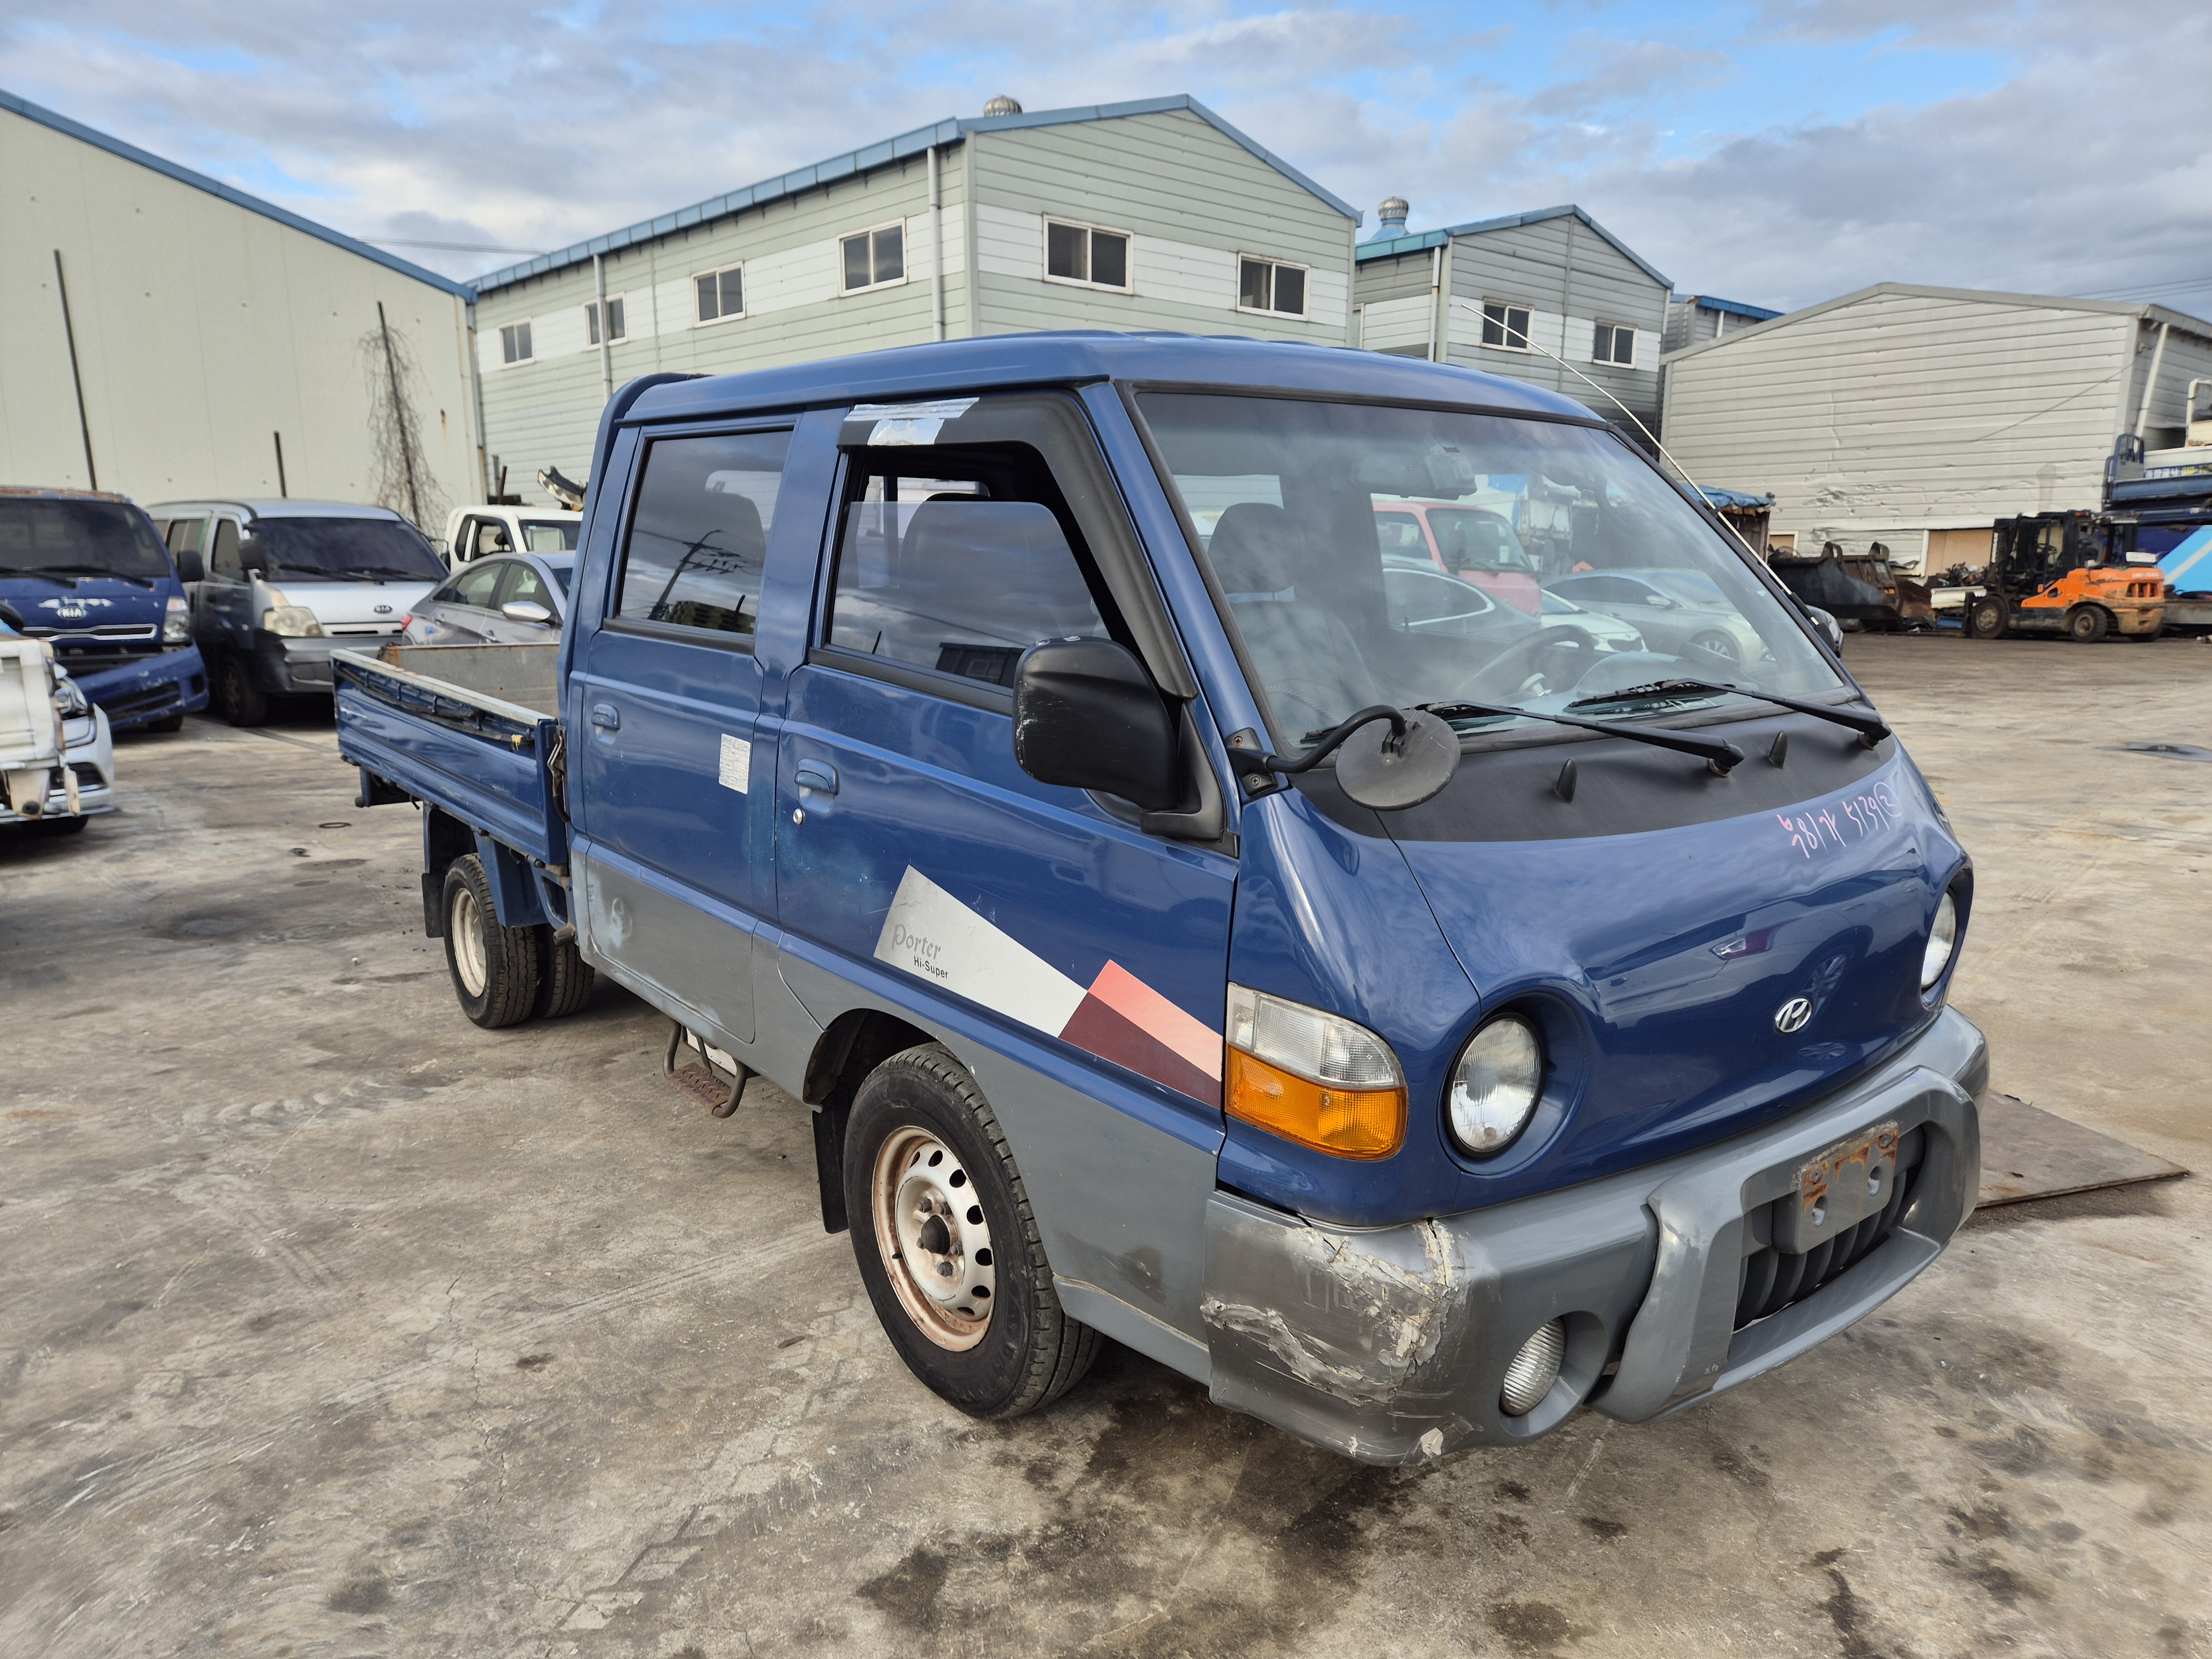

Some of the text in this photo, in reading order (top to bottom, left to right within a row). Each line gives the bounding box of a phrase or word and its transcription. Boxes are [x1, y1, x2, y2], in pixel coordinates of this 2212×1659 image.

[61, 608, 83, 618] KIA
[891, 924, 941, 960] Porter
[914, 955, 948, 979] Hi-Super
